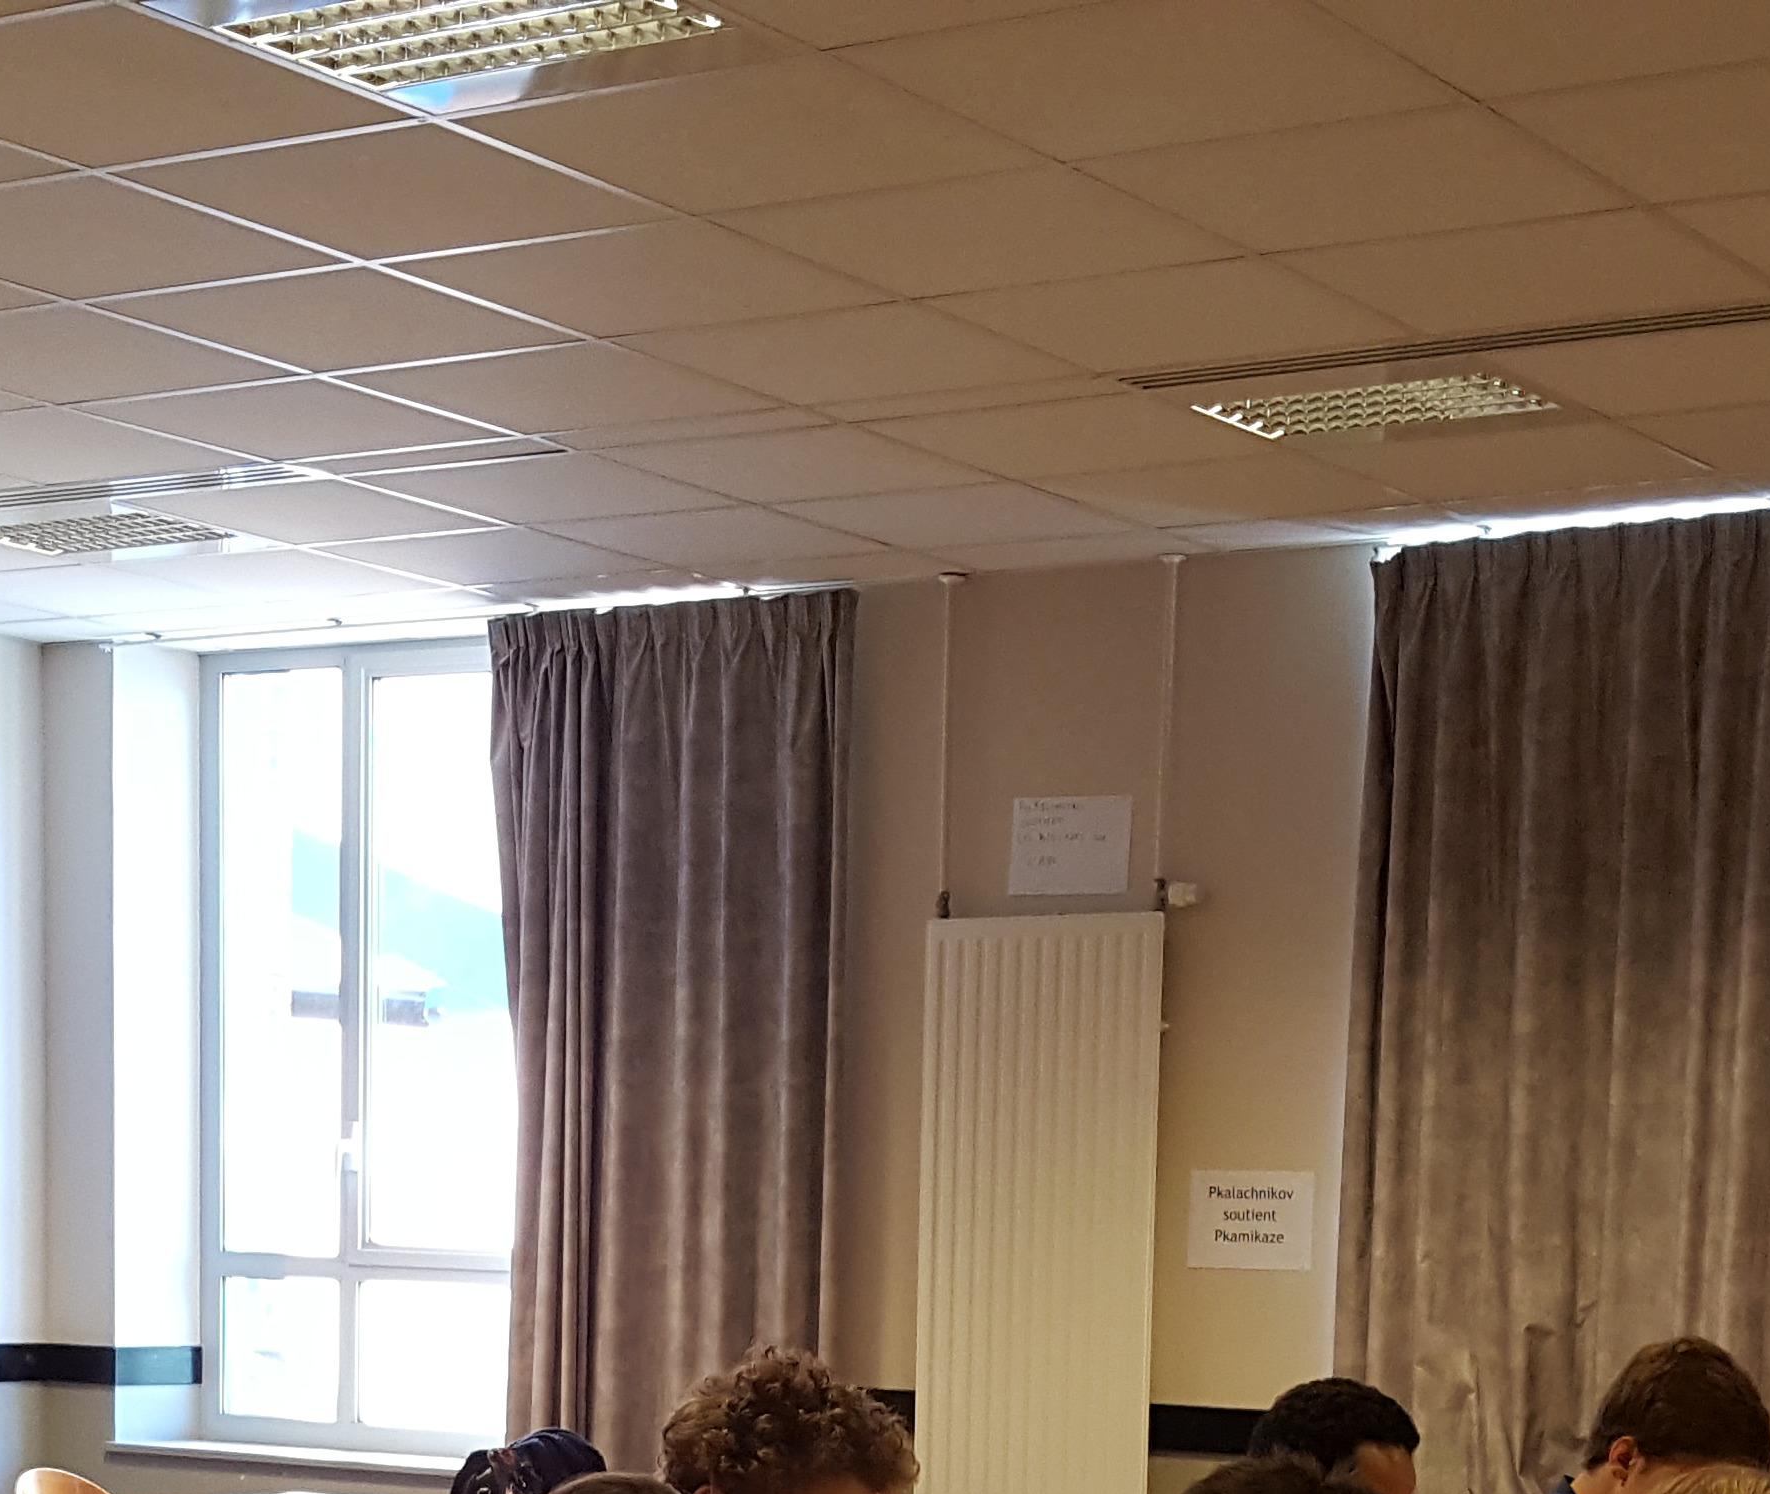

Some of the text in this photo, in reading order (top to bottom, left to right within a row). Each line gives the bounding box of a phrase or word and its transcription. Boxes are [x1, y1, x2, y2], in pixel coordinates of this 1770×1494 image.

[1208, 1185, 1294, 1200] Pkalachnikov
[1223, 1209, 1277, 1222] soutient
[1214, 1229, 1285, 1244] Pkamikaze
